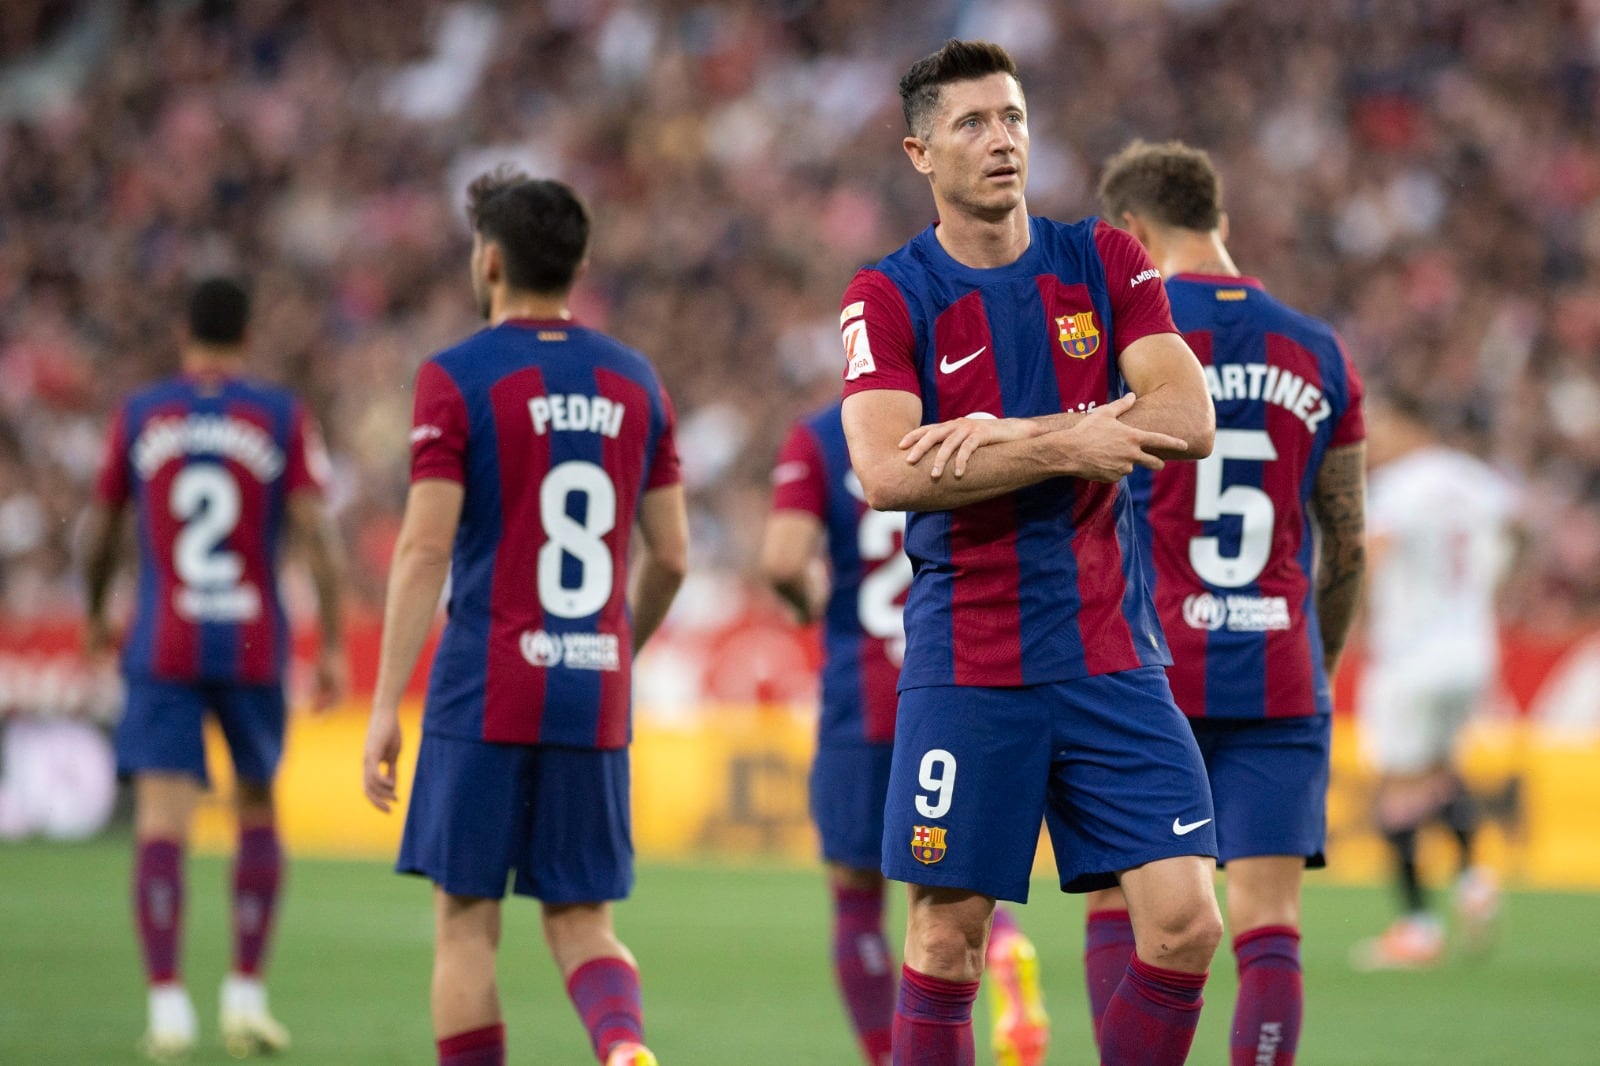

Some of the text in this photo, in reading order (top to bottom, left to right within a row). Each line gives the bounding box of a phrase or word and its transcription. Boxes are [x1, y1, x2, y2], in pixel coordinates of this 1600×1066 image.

[528, 393, 625, 438] PEDRI
[1203, 363, 1332, 434] ARTINEZ
[172, 463, 243, 587] 2
[538, 460, 616, 619] 8
[1189, 429, 1278, 588] 5
[915, 748, 957, 819] 9
